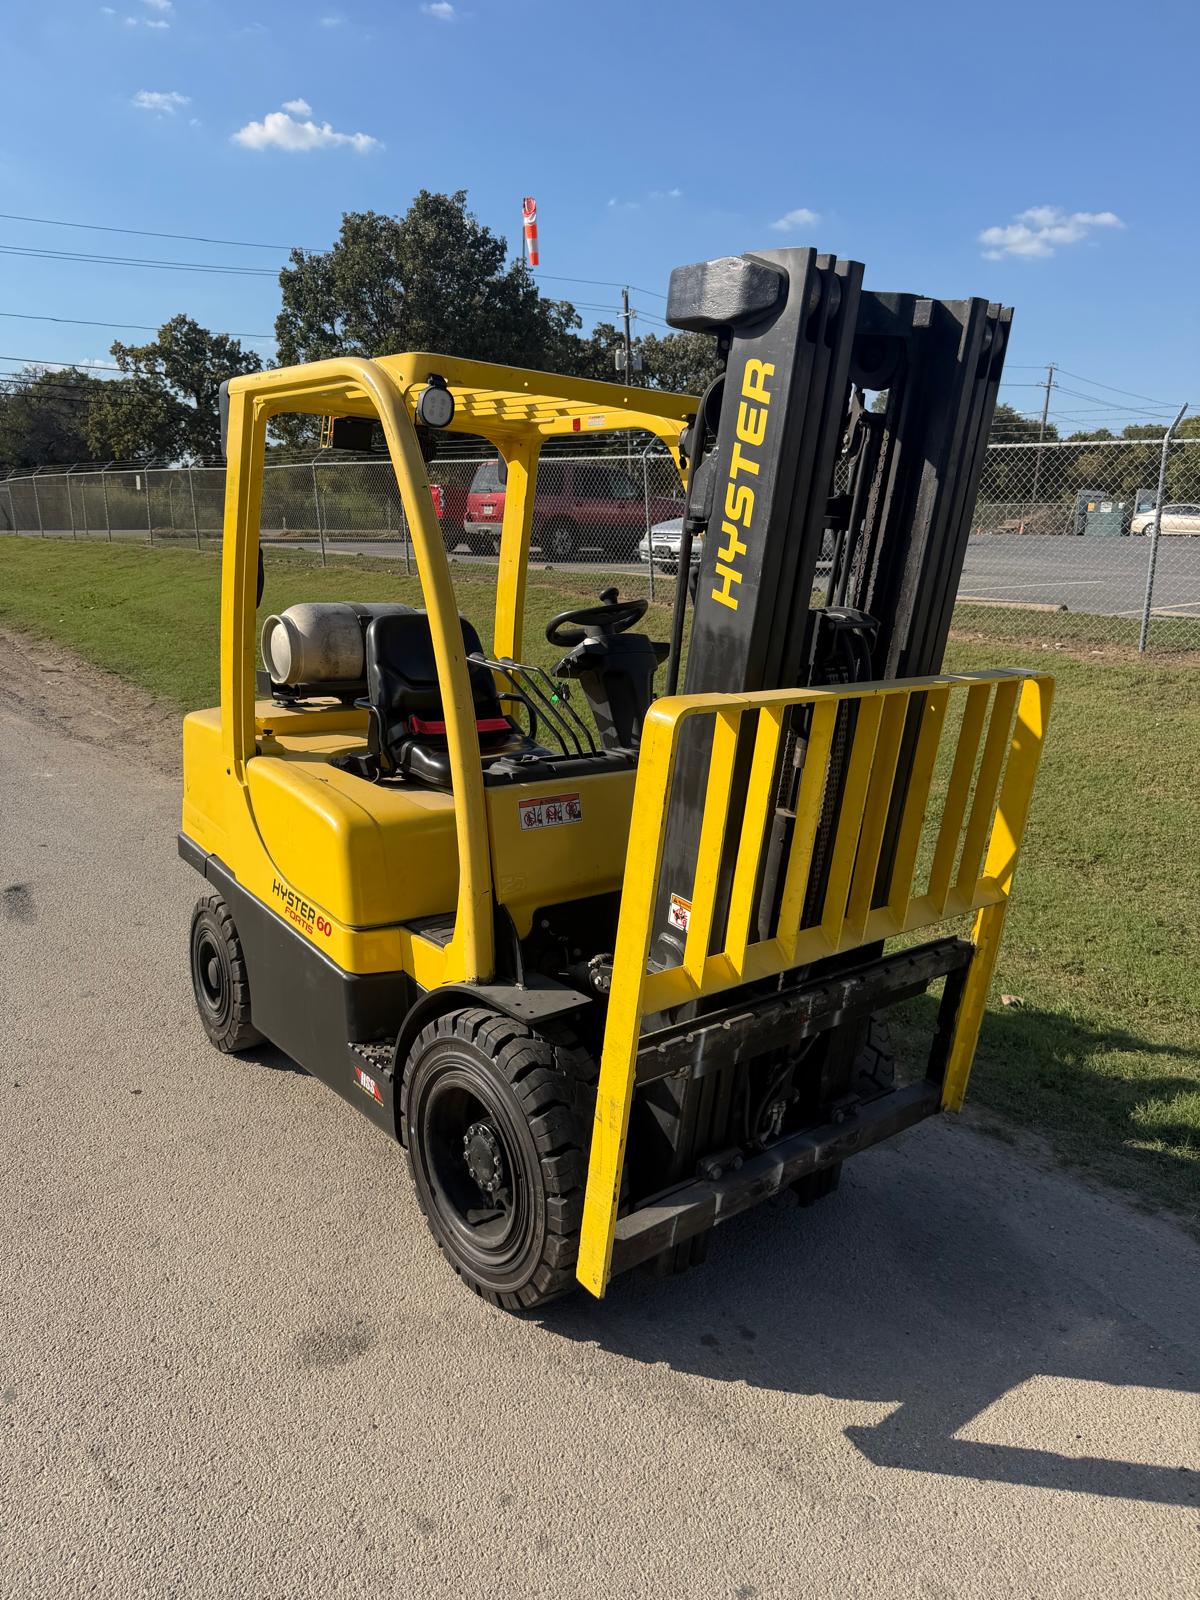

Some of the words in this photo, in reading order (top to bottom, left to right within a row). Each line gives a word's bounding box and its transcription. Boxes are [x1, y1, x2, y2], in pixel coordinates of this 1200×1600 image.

[711, 358, 775, 611] HYSTER
[272, 878, 316, 925] HYSTER
[316, 915, 332, 937] 60
[285, 906, 314, 935] FORTIS
